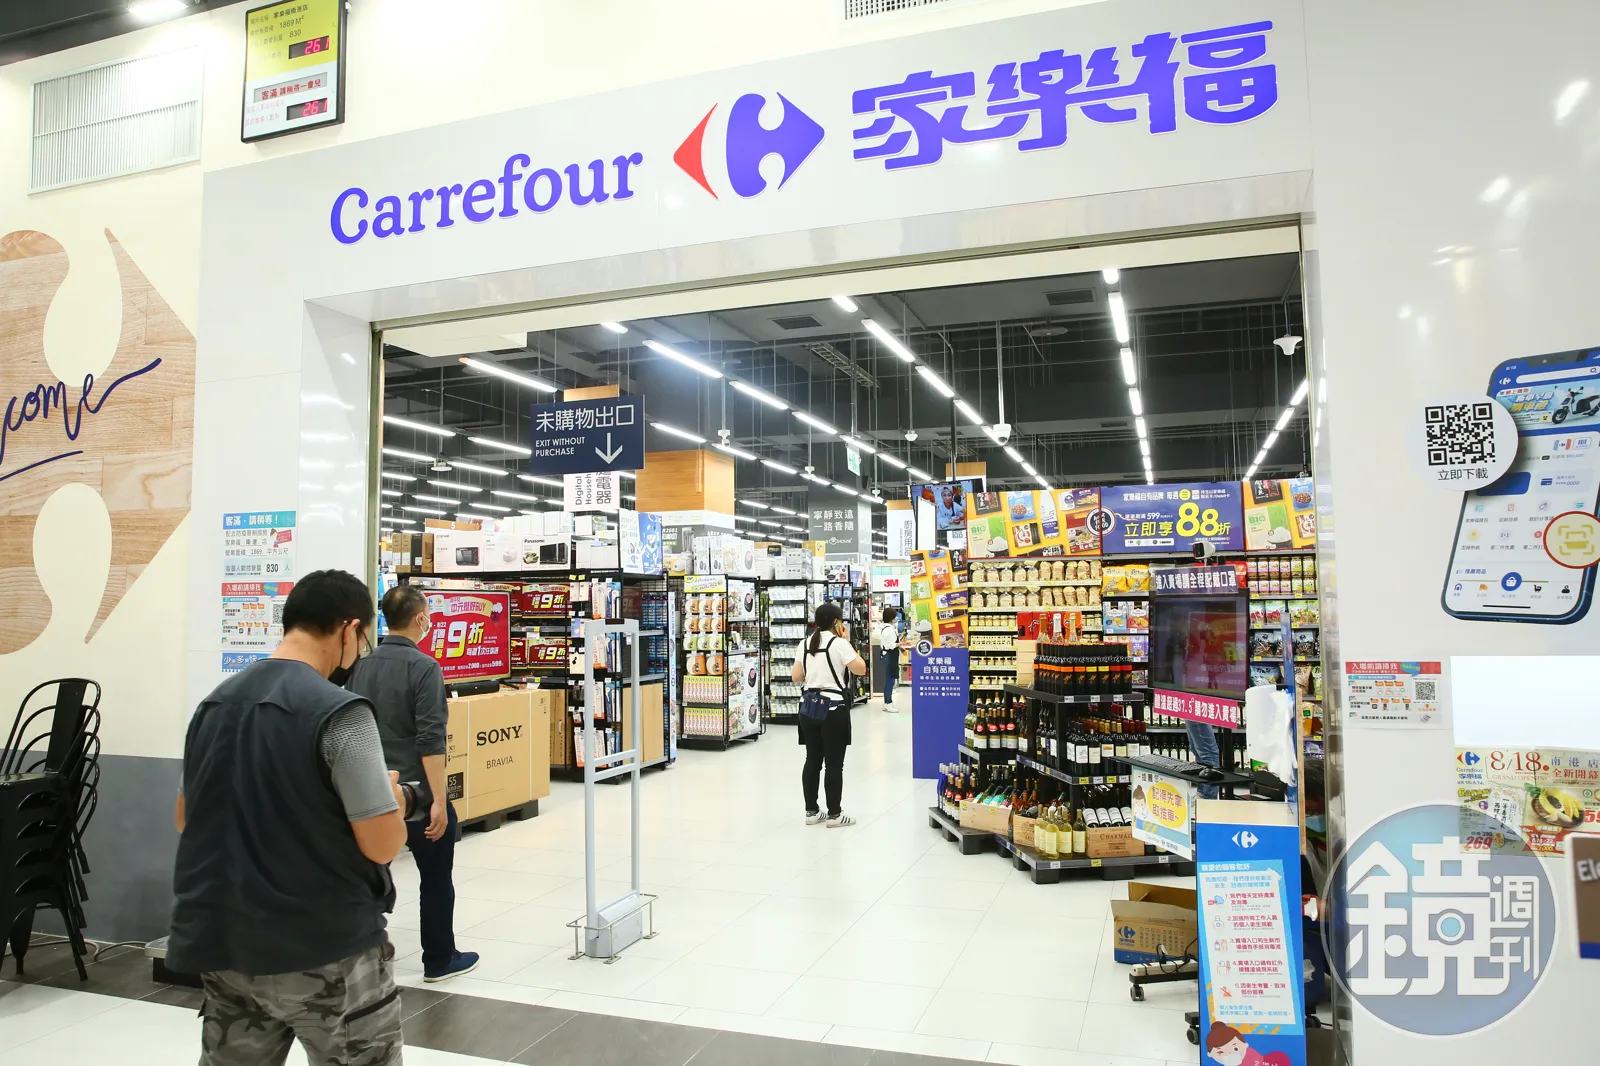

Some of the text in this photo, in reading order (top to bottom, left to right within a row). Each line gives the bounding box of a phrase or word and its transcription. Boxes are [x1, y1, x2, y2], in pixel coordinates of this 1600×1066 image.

[289, 28, 302, 38] 830
[304, 36, 330, 55] 261
[853, 21, 1280, 169] 家樂福
[302, 99, 328, 117] 261
[329, 152, 644, 246] Carrefour
[535, 404, 634, 433] 未購物出口
[535, 437, 585, 448] EXIT WITHOUT
[535, 447, 575, 457] PURCHASE
[1437, 467, 1489, 481] 立即下載
[1146, 512, 1161, 520] 599
[266, 563, 279, 573] 830
[883, 578, 899, 588] 3M
[927, 656, 952, 666] 家樂福
[923, 665, 956, 674] 自有品牌
[476, 725, 523, 747] SONY
[486, 755, 514, 769] BRAVIA
[1551, 756, 1599, 769] 南港店
[1553, 768, 1599, 780] 全新開幕
[449, 776, 457, 787] 55
[1463, 835, 1493, 850] 269
